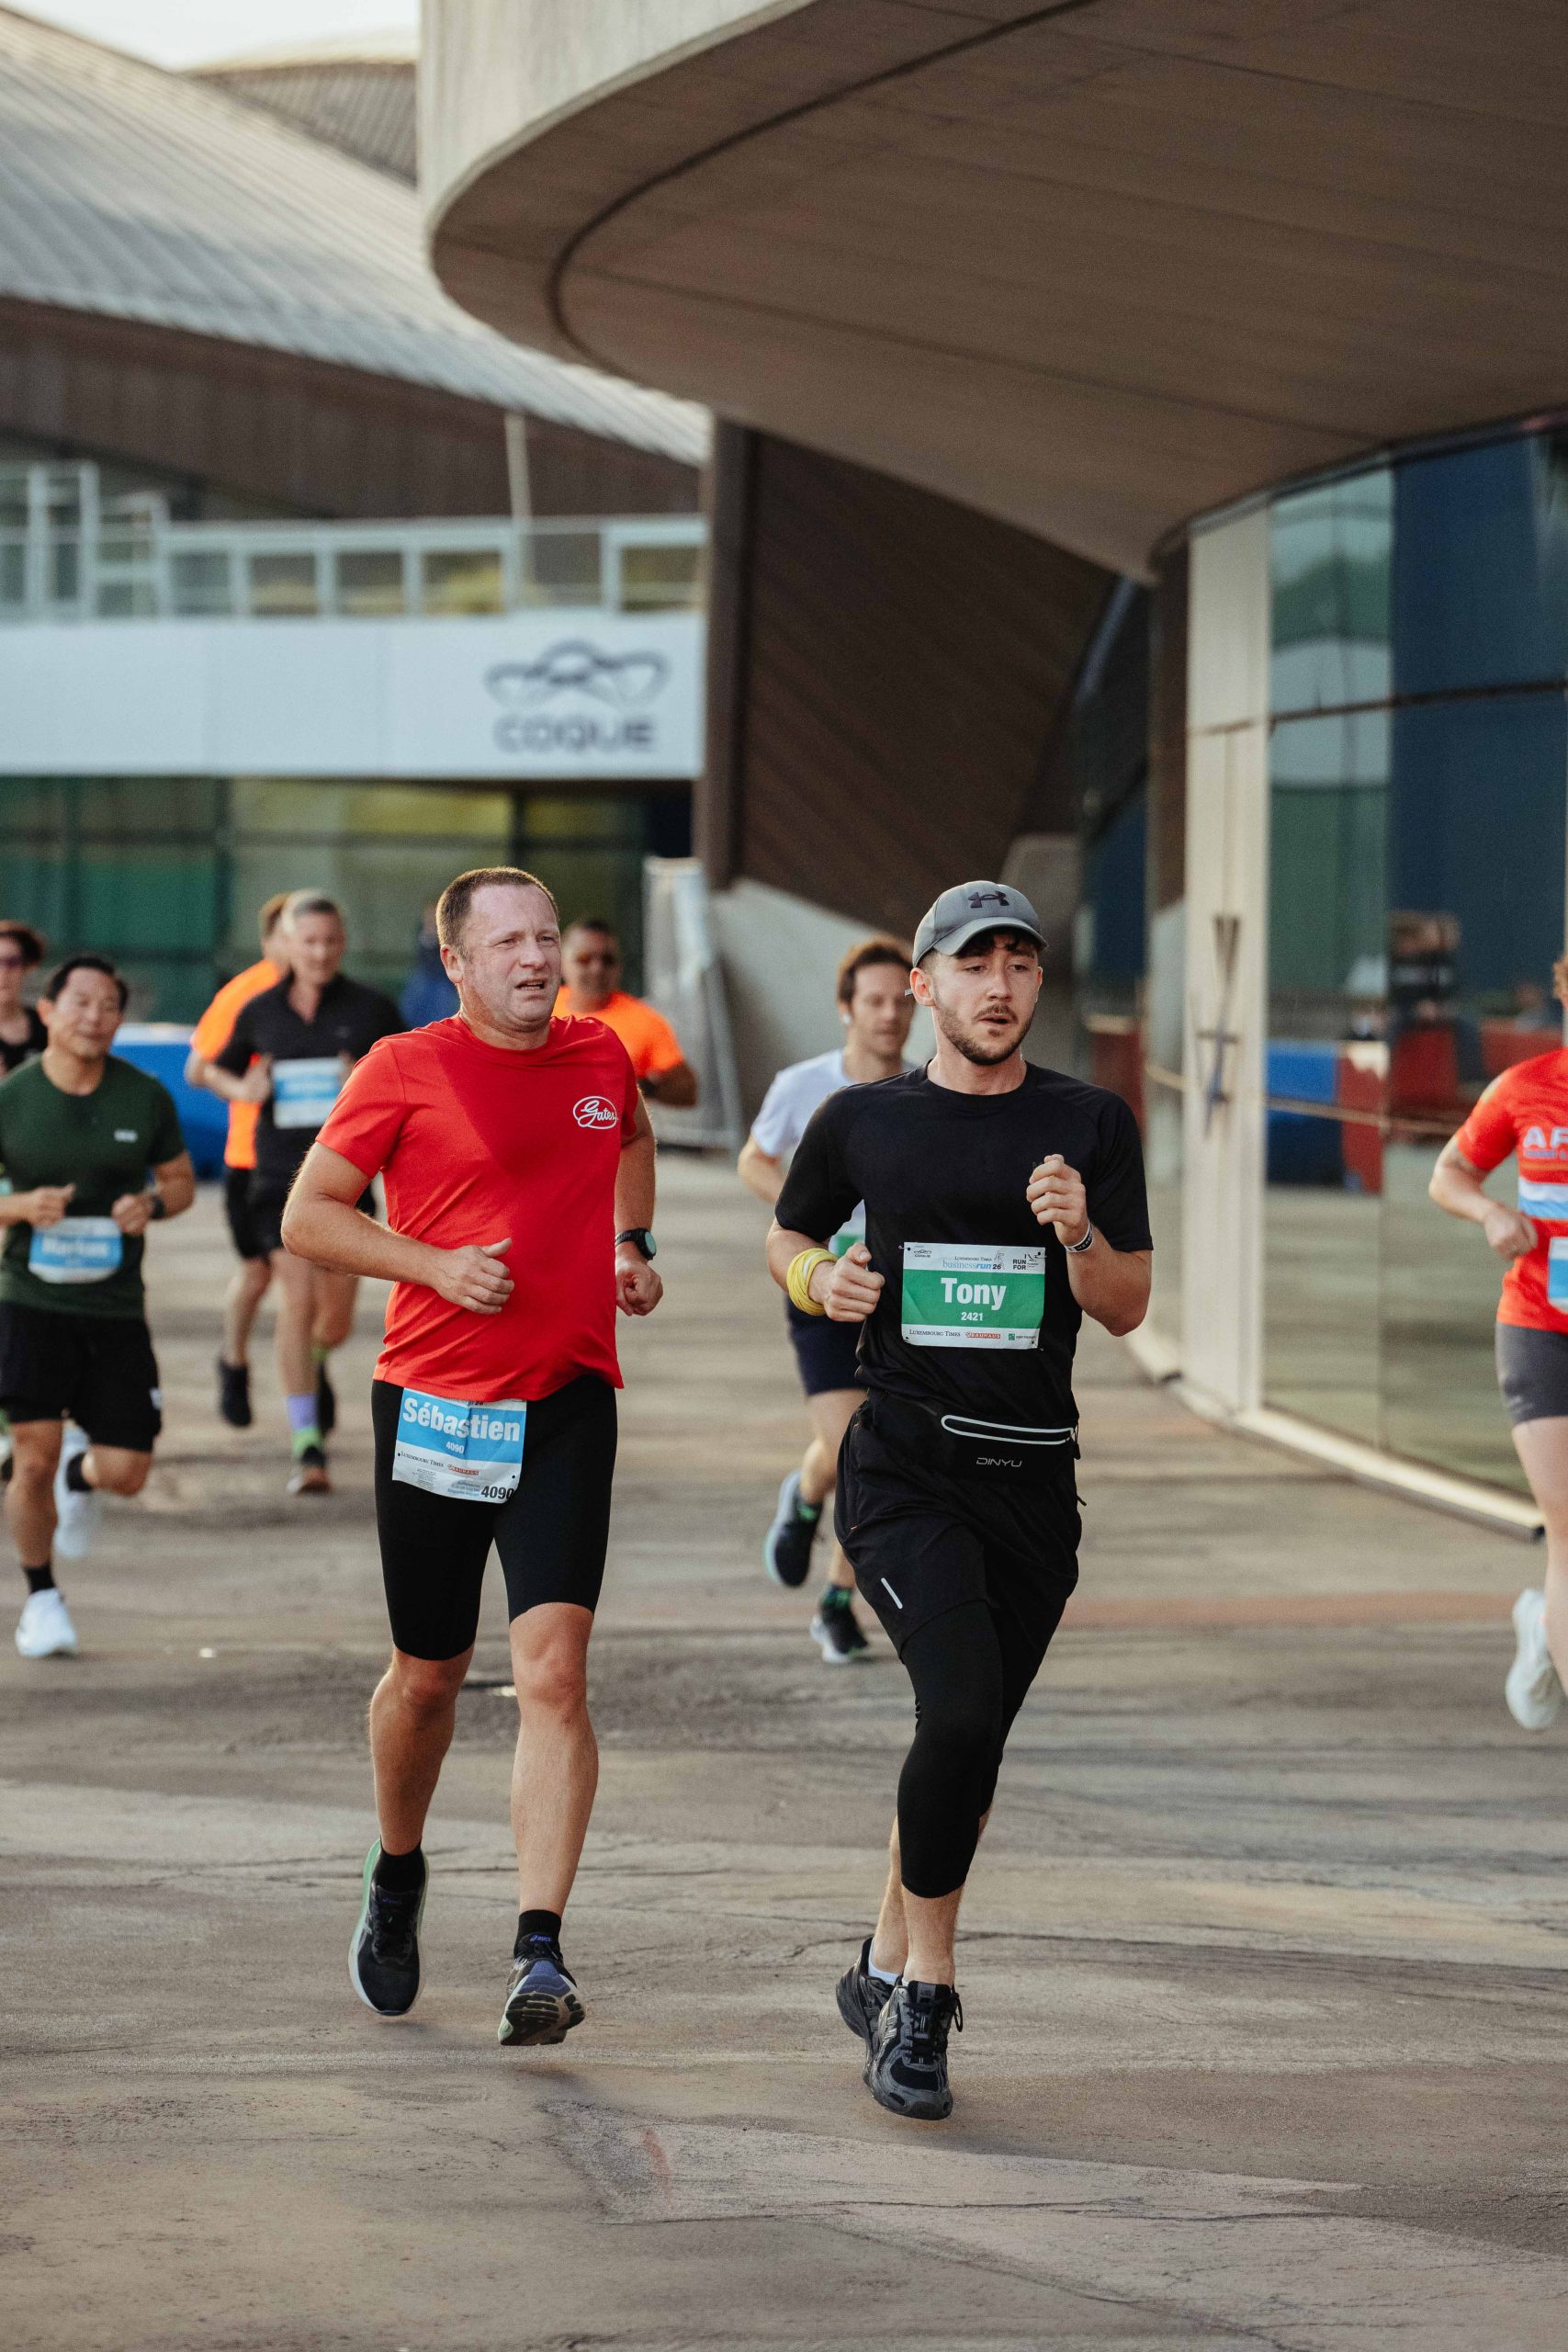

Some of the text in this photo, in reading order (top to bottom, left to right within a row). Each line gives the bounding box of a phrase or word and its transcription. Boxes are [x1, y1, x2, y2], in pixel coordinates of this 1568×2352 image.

[494, 714, 658, 754] COQUE
[578, 1099, 619, 1128] Gates
[941, 1277, 1007, 1310] Tony
[961, 1312, 984, 1321] 2421
[402, 1397, 521, 1442] Sébastien
[446, 1442, 466, 1454] 4090
[976, 1457, 1022, 1467] DINYU
[481, 1486, 514, 1499] 4090
